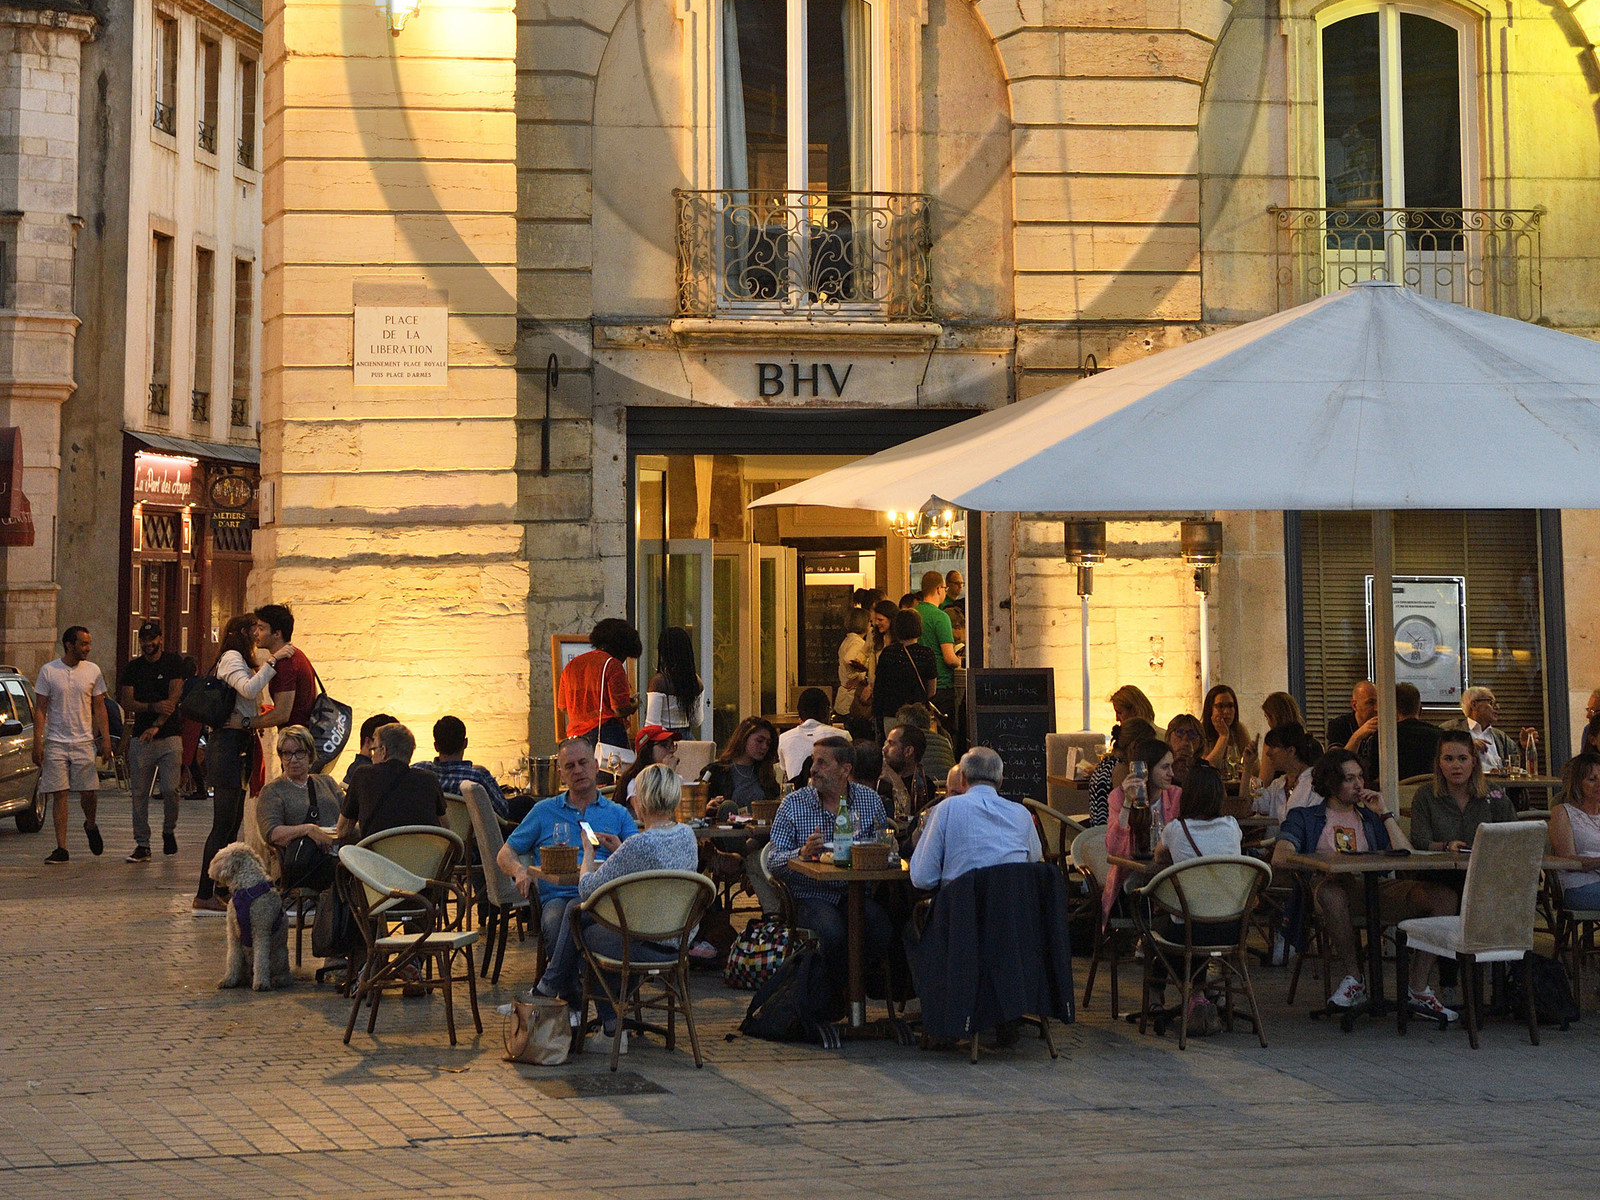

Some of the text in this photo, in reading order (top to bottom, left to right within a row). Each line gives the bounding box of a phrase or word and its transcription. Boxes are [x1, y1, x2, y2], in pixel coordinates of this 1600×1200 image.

[385, 315, 419, 325] PLACE
[383, 330, 420, 339] DE LA
[370, 345, 433, 354] LIBERATION
[755, 363, 853, 397] BHV
[134, 466, 144, 492] La
[145, 467, 161, 494] Part
[161, 469, 171, 494] des
[172, 470, 191, 500] Anges
[218, 520, 241, 528] D'ART
[323, 712, 347, 753] adidas
